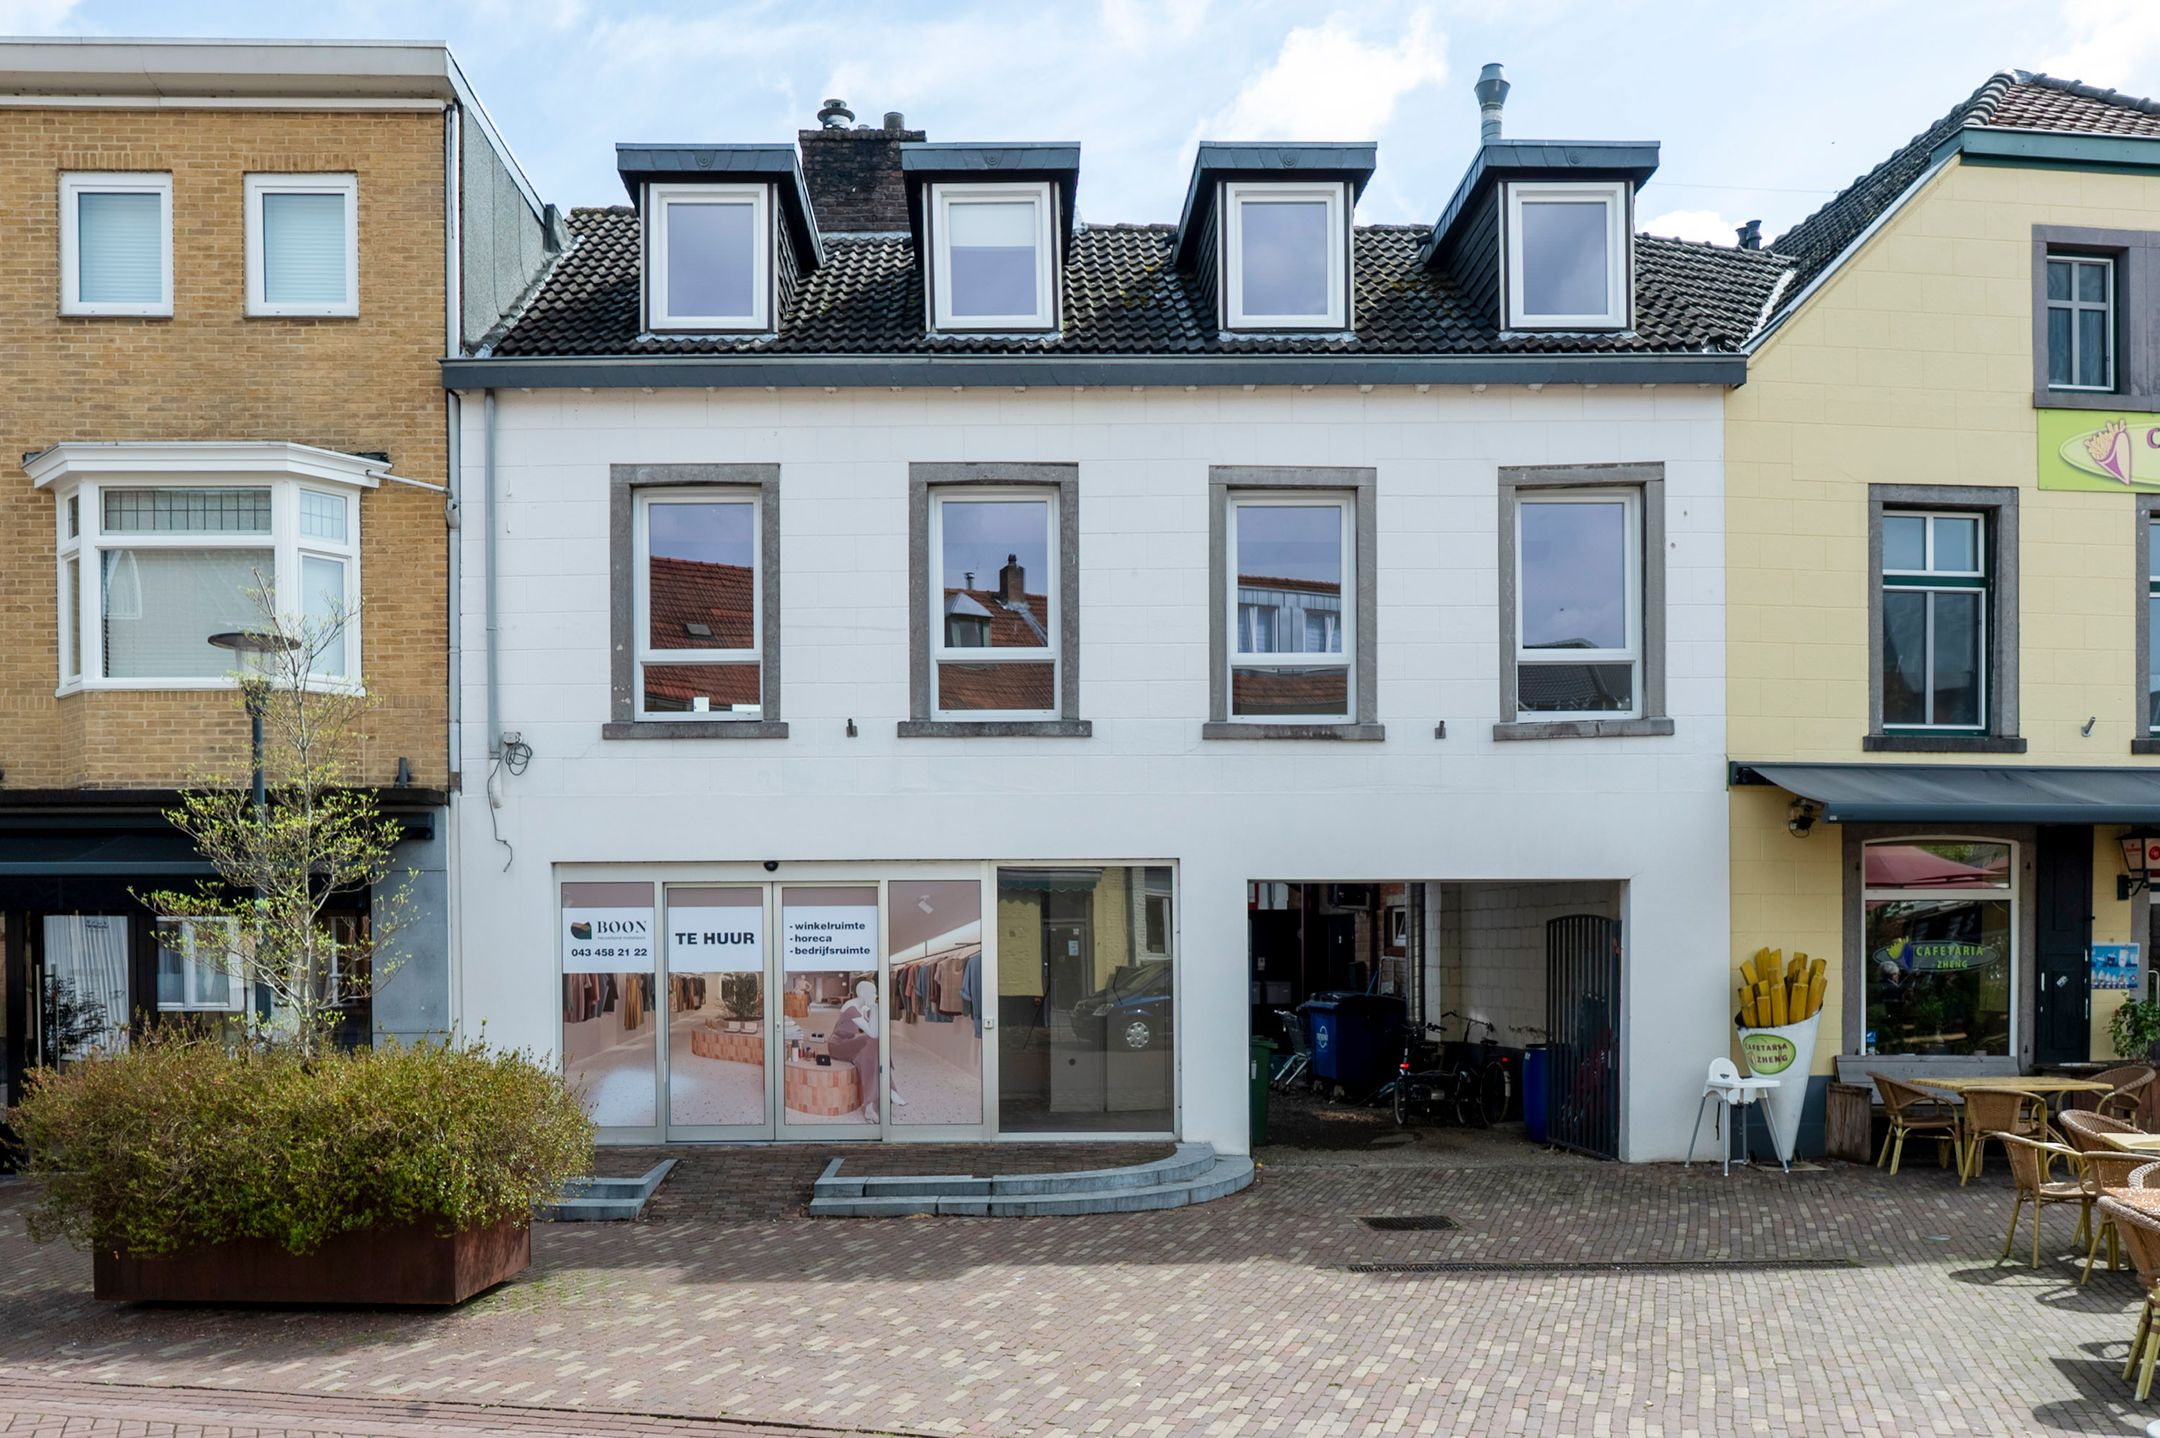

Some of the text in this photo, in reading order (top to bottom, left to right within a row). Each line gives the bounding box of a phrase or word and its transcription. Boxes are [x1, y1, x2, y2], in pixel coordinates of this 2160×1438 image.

[597, 920, 647, 934] BOON
[795, 921, 866, 930] winkelruimte
[675, 932, 755, 945] TE HUUR
[794, 934, 833, 943] horeca
[571, 948, 648, 957] 043 458 21 22
[794, 946, 871, 957] bedrijfsruimte
[1915, 945, 1984, 957] CAFETARIA
[1937, 960, 1968, 969] ZHENG
[1757, 1054, 1788, 1064] ZHENG
